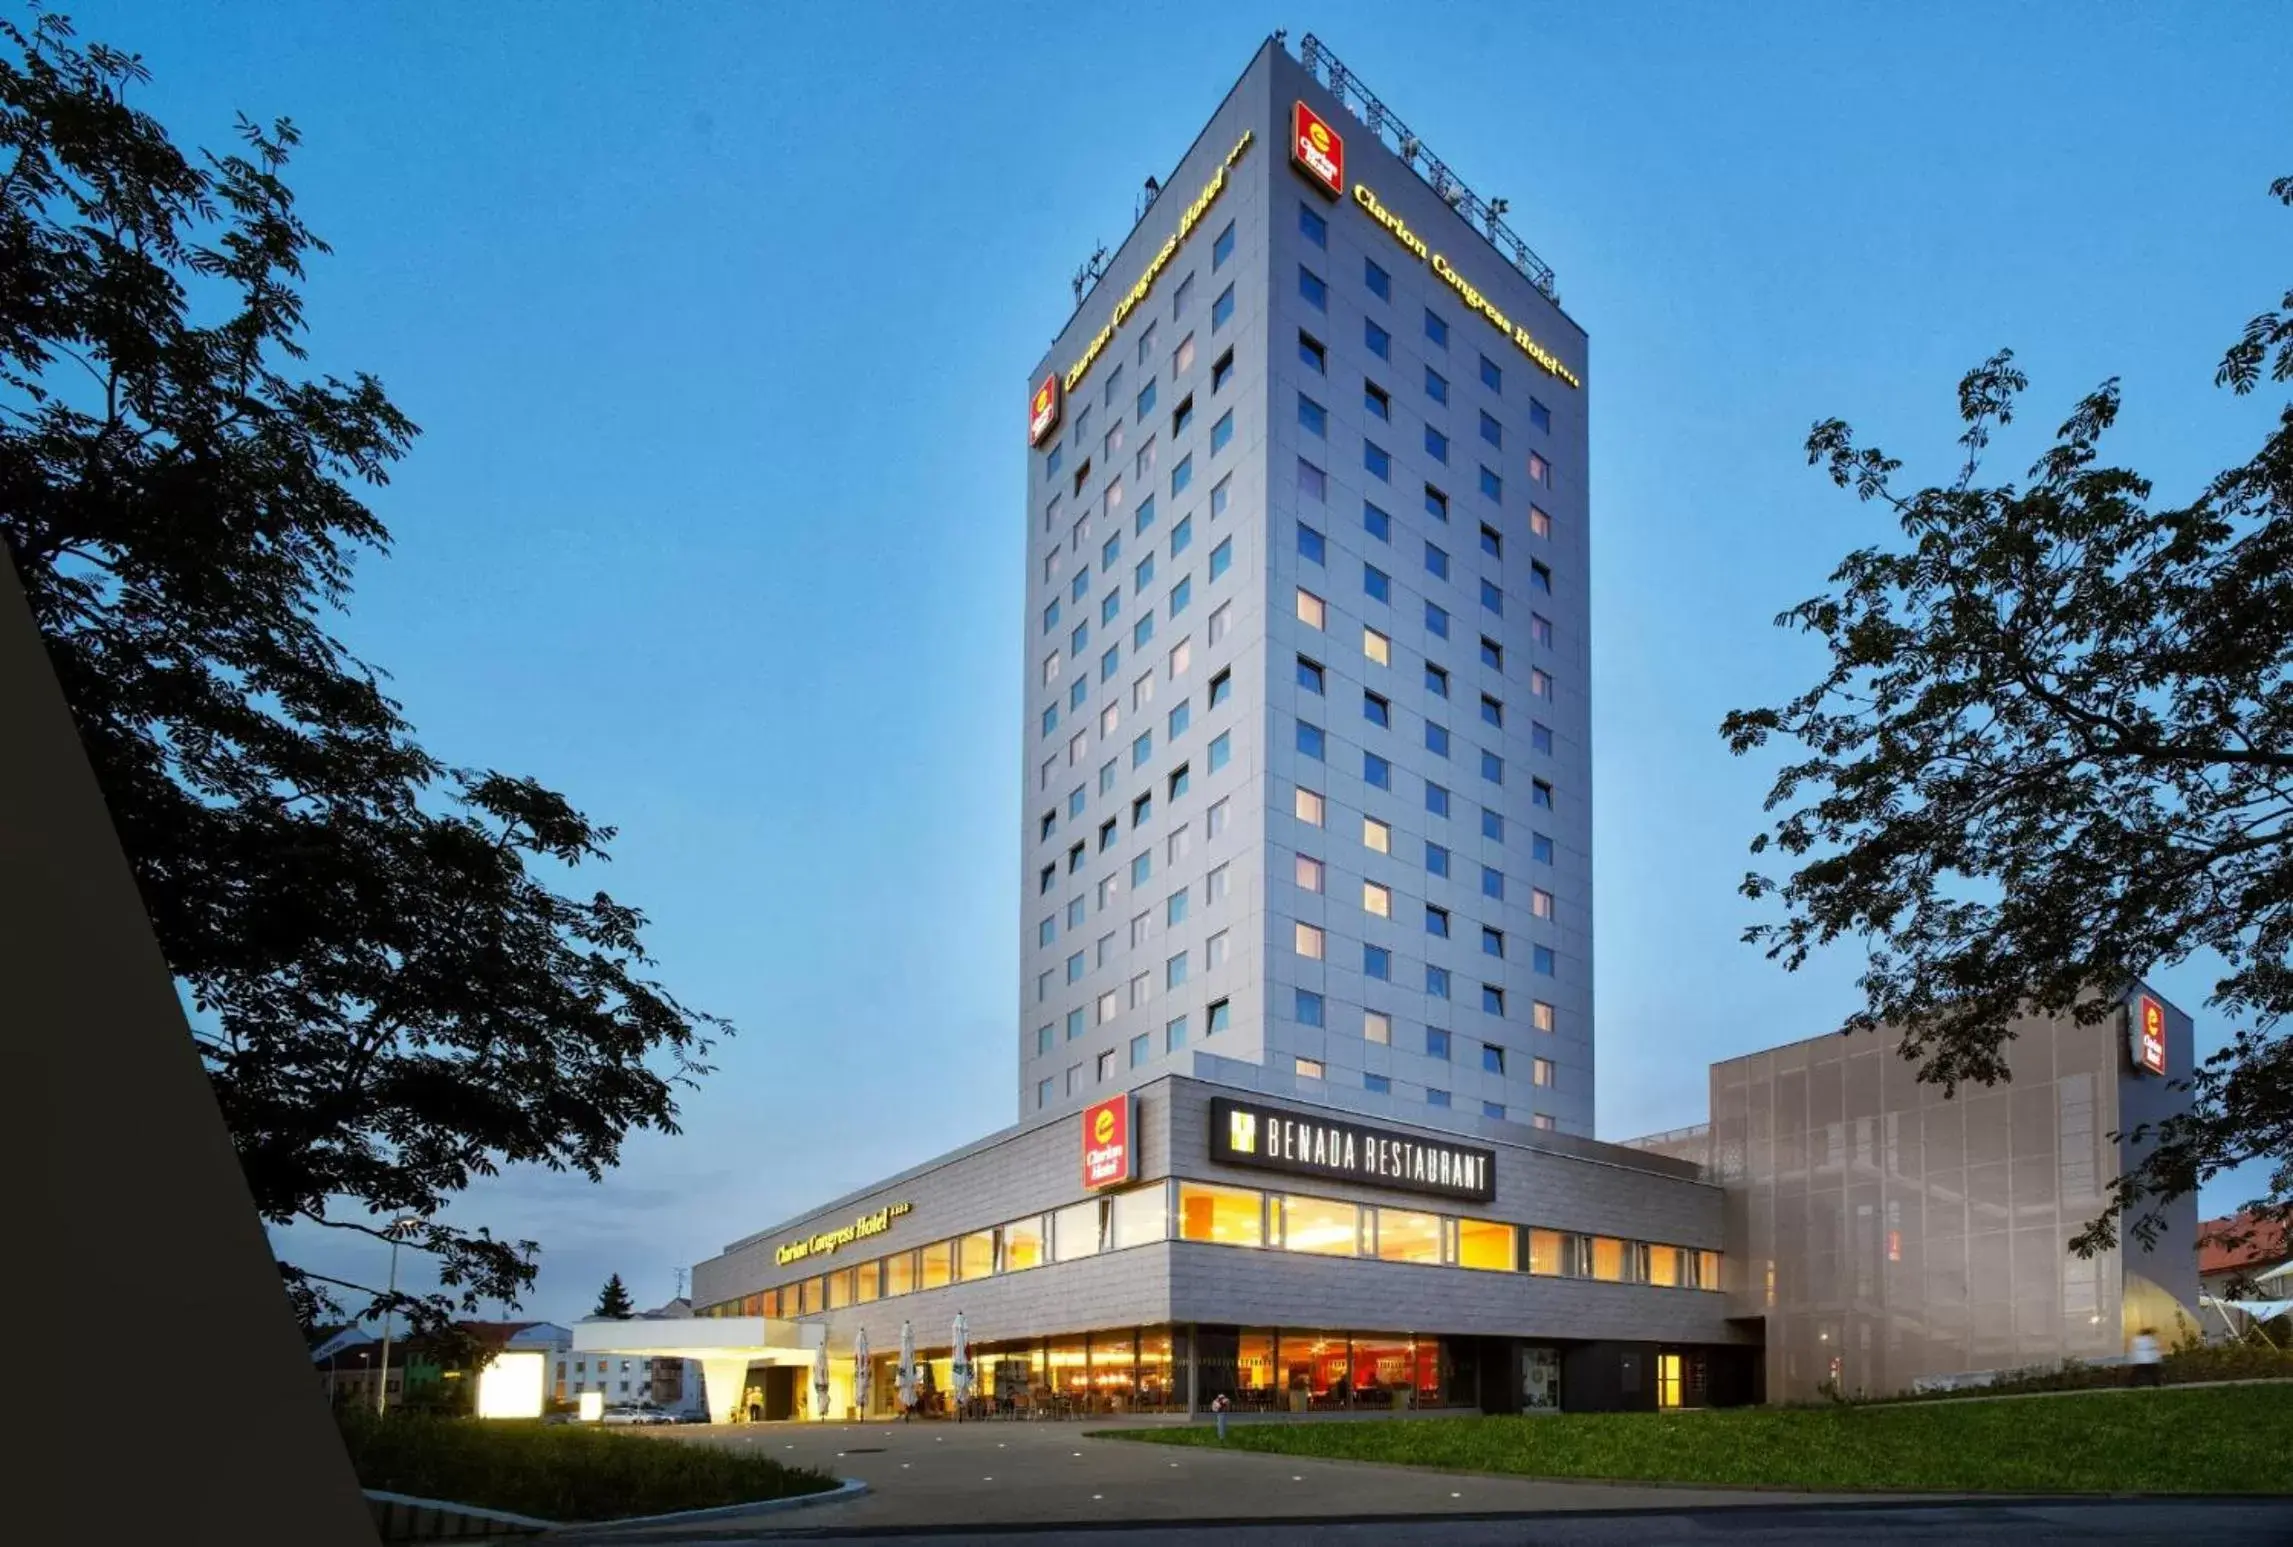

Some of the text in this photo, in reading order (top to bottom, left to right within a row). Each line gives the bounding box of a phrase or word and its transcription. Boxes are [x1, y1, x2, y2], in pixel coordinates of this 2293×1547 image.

[1064, 165, 1225, 392] Clarion Congress Hotel
[1353, 184, 1558, 375] Clarion Congress Hotel
[1268, 1117, 1487, 1191] BENADA RESTAURANT
[776, 1205, 889, 1266] Clarion Congress Hotel
